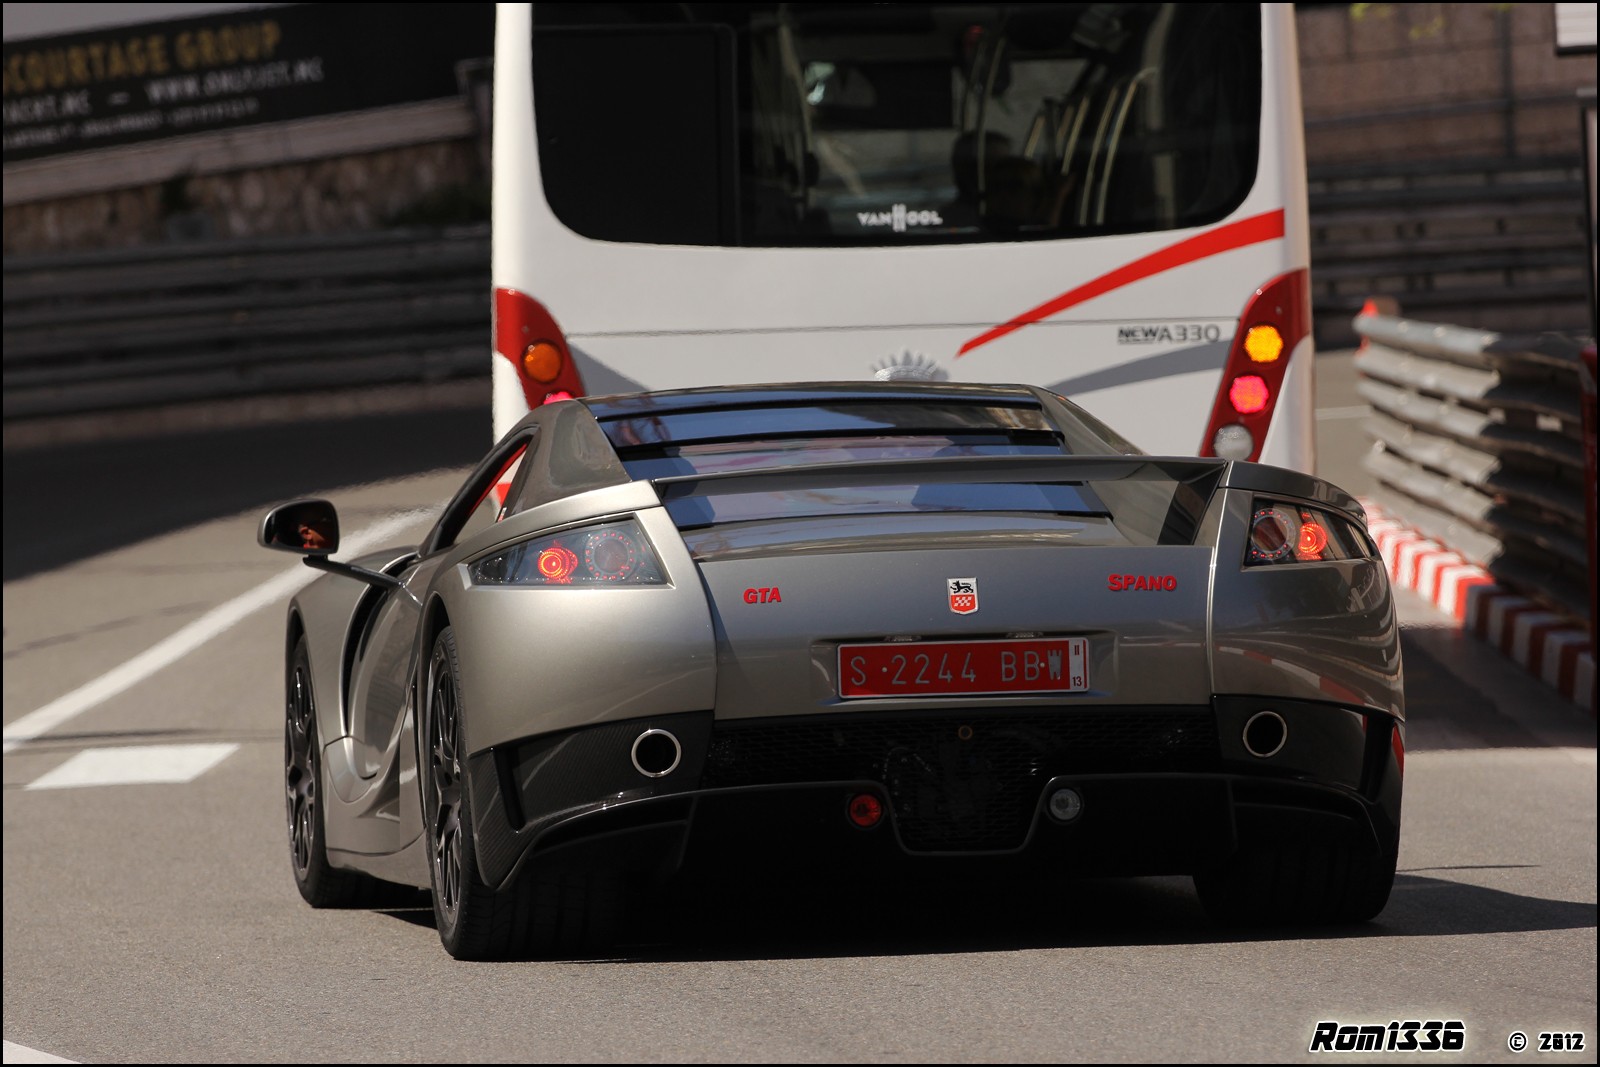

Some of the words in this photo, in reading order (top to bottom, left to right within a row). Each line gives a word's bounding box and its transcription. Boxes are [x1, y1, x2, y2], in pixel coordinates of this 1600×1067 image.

[175, 20, 282, 70] GROUP
[1107, 573, 1177, 591] SPANO
[743, 586, 782, 604] GTA
[850, 655, 867, 686] S
[891, 652, 977, 685] 2244
[1072, 675, 1083, 687] 13
